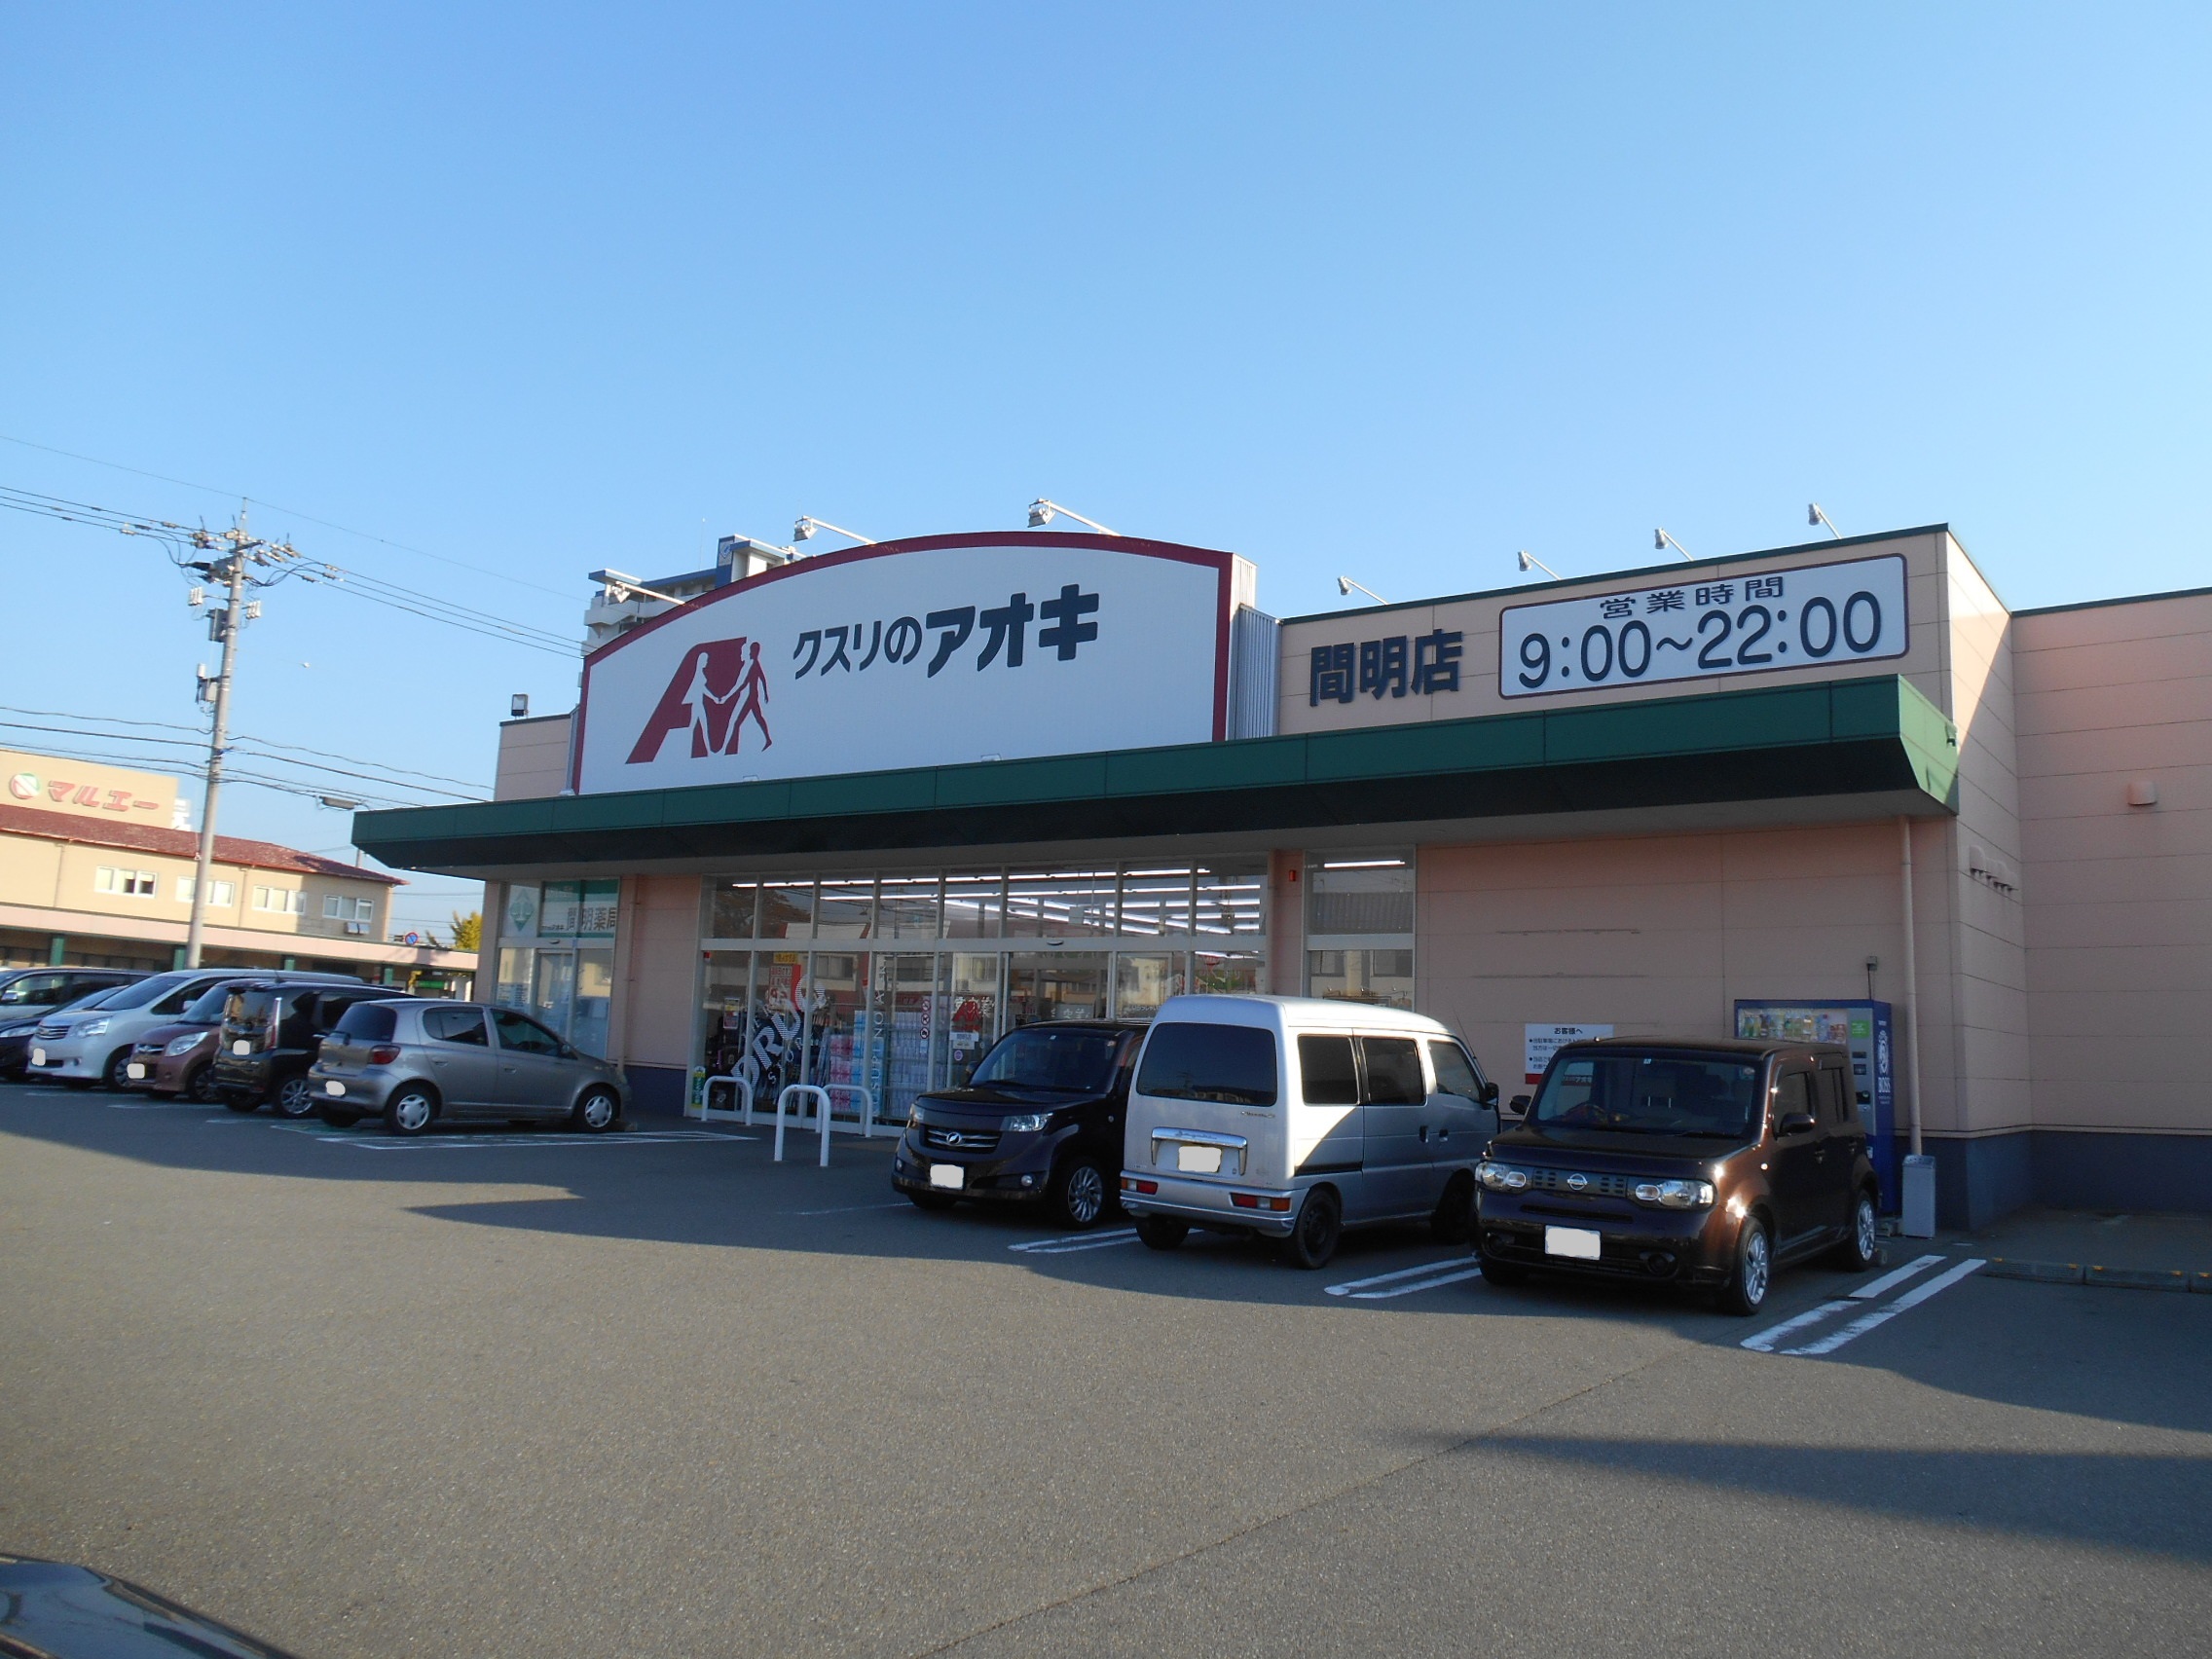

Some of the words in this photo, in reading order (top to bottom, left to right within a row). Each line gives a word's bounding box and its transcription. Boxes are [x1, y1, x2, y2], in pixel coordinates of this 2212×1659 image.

[1601, 576, 1784, 618] 営業時間
[793, 582, 1100, 679] クスリのアオキ
[1309, 629, 1462, 707] 間明店
[48, 780, 160, 812] マルエー
